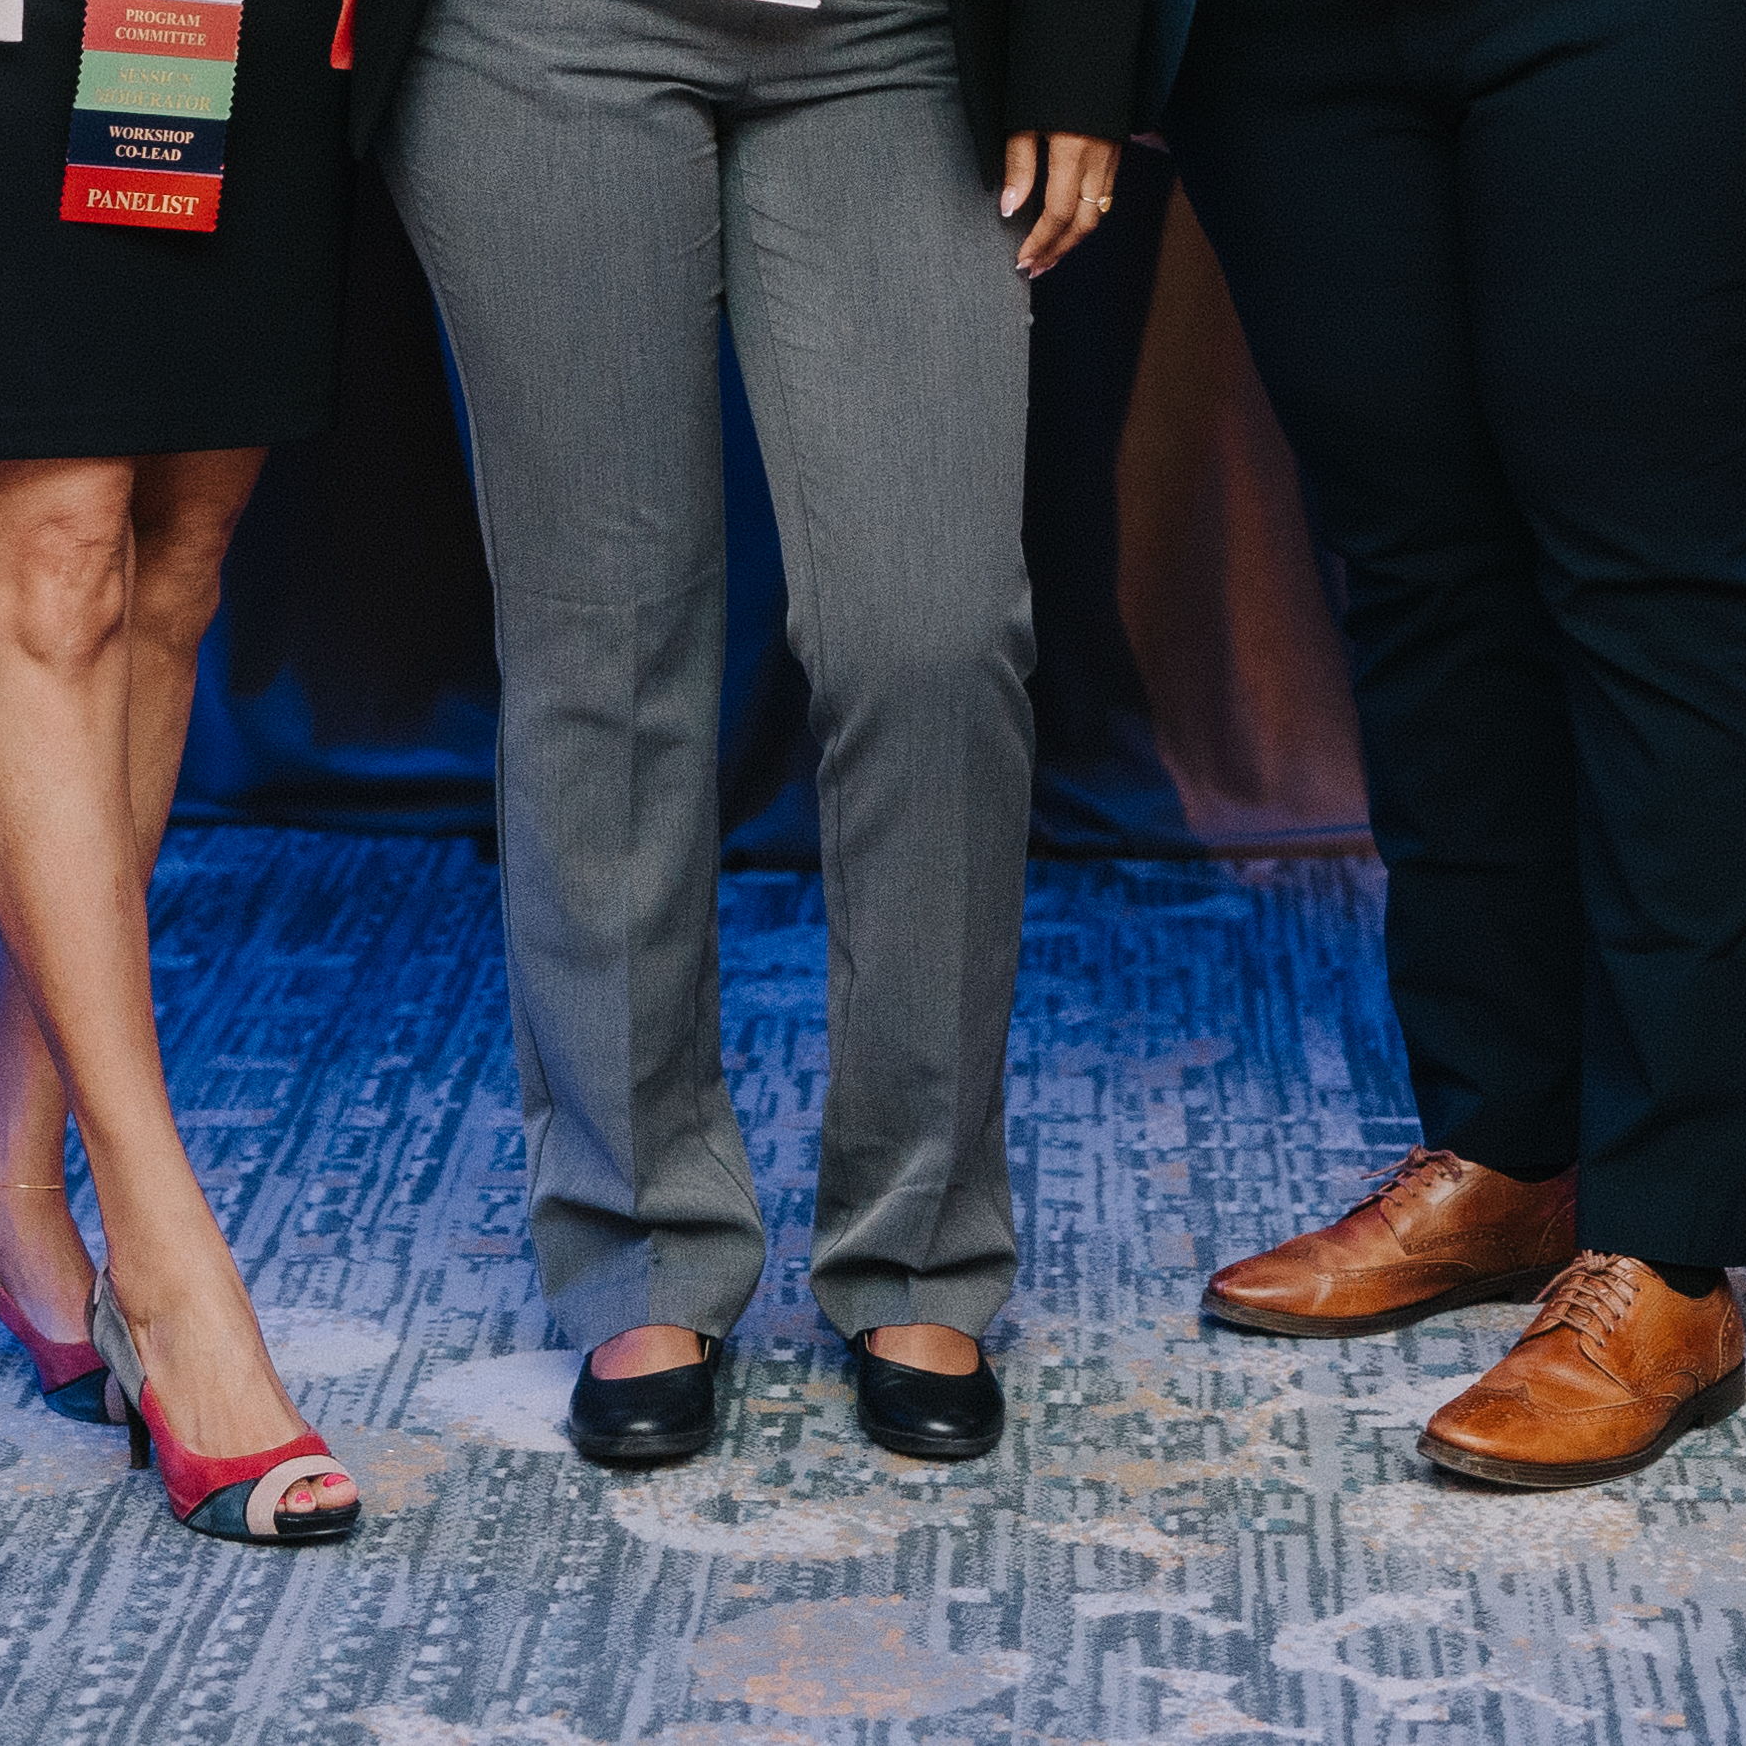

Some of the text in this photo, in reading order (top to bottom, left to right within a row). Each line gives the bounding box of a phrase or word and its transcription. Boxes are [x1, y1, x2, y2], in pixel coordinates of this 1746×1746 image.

[126, 9, 200, 27] PROGRAM
[115, 27, 206, 46] COMMITTEE
[118, 67, 193, 86] SESSION
[92, 88, 211, 112] MODERATOR
[109, 126, 194, 144] WORKSHOP
[115, 145, 182, 161] CO-LEAD
[86, 188, 199, 216] PANELIST
